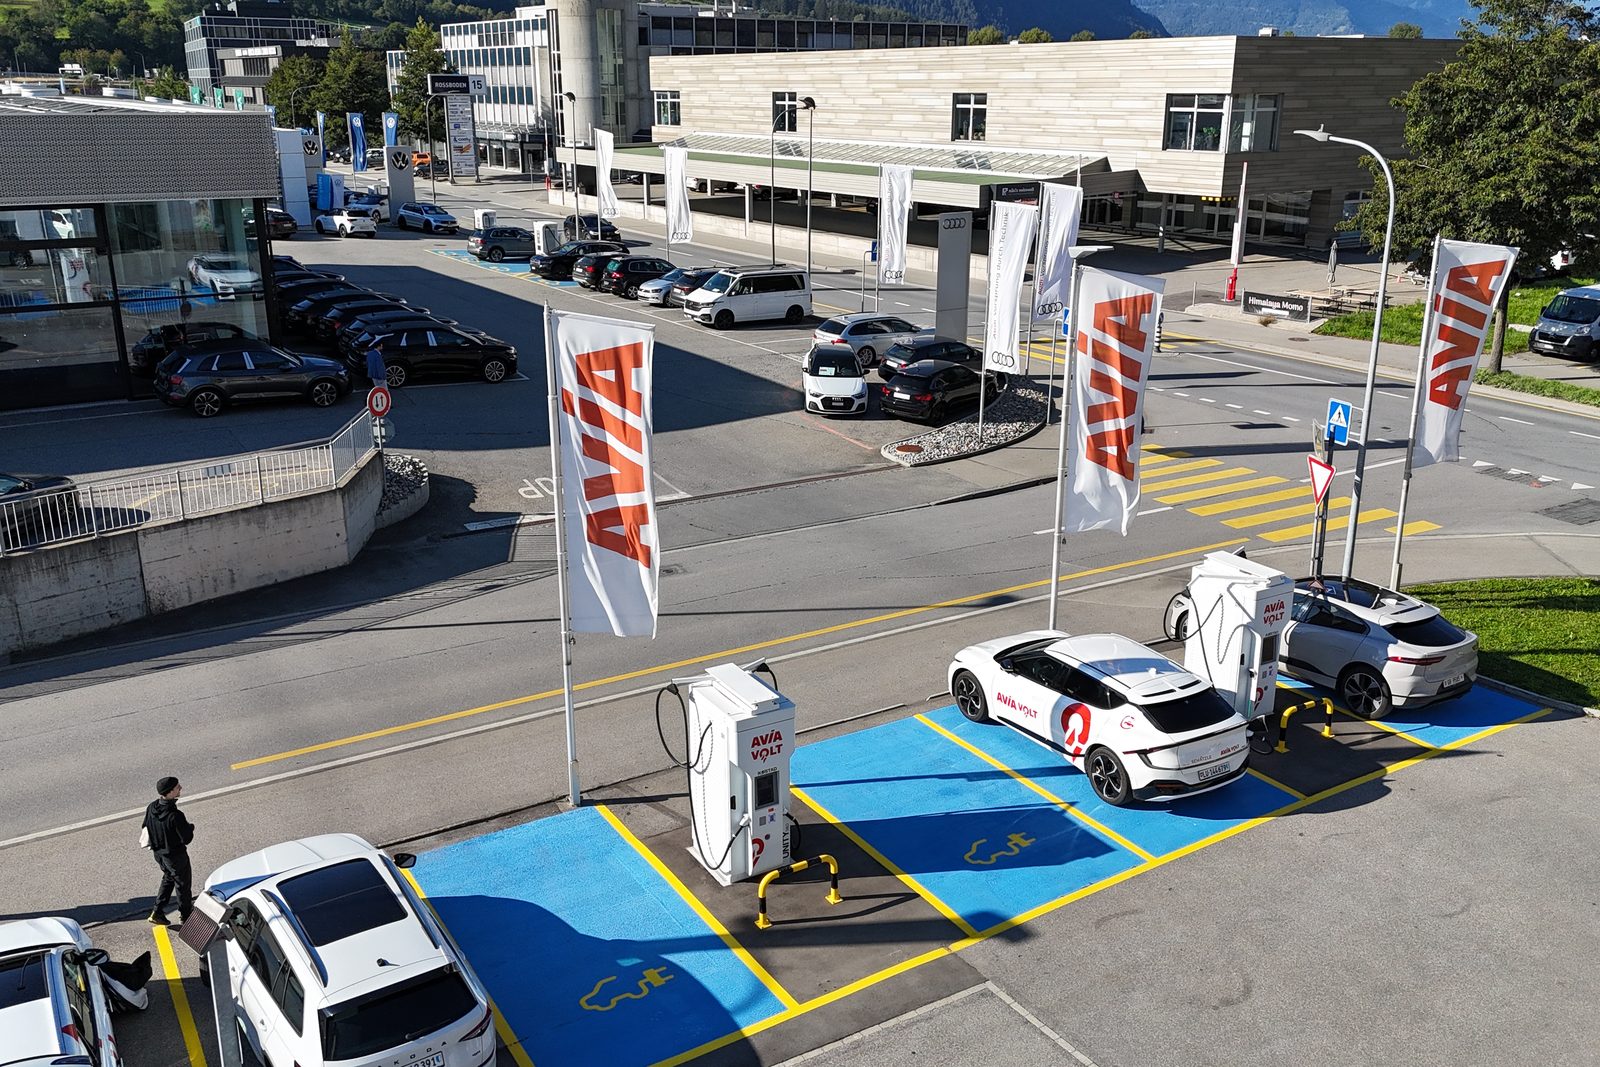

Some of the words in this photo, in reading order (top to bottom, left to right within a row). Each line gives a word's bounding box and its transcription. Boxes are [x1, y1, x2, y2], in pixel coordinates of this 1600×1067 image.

[471, 80, 482, 90] 15
[998, 211, 1010, 244] Technik
[995, 245, 1004, 271] durch
[1248, 296, 1281, 310] Himalaya
[1281, 301, 1304, 312] Momo
[1263, 612, 1285, 627] VOLT
[1017, 702, 1038, 718] VOLT
[751, 744, 783, 763] VOLT
[782, 831, 790, 859] UNITY
